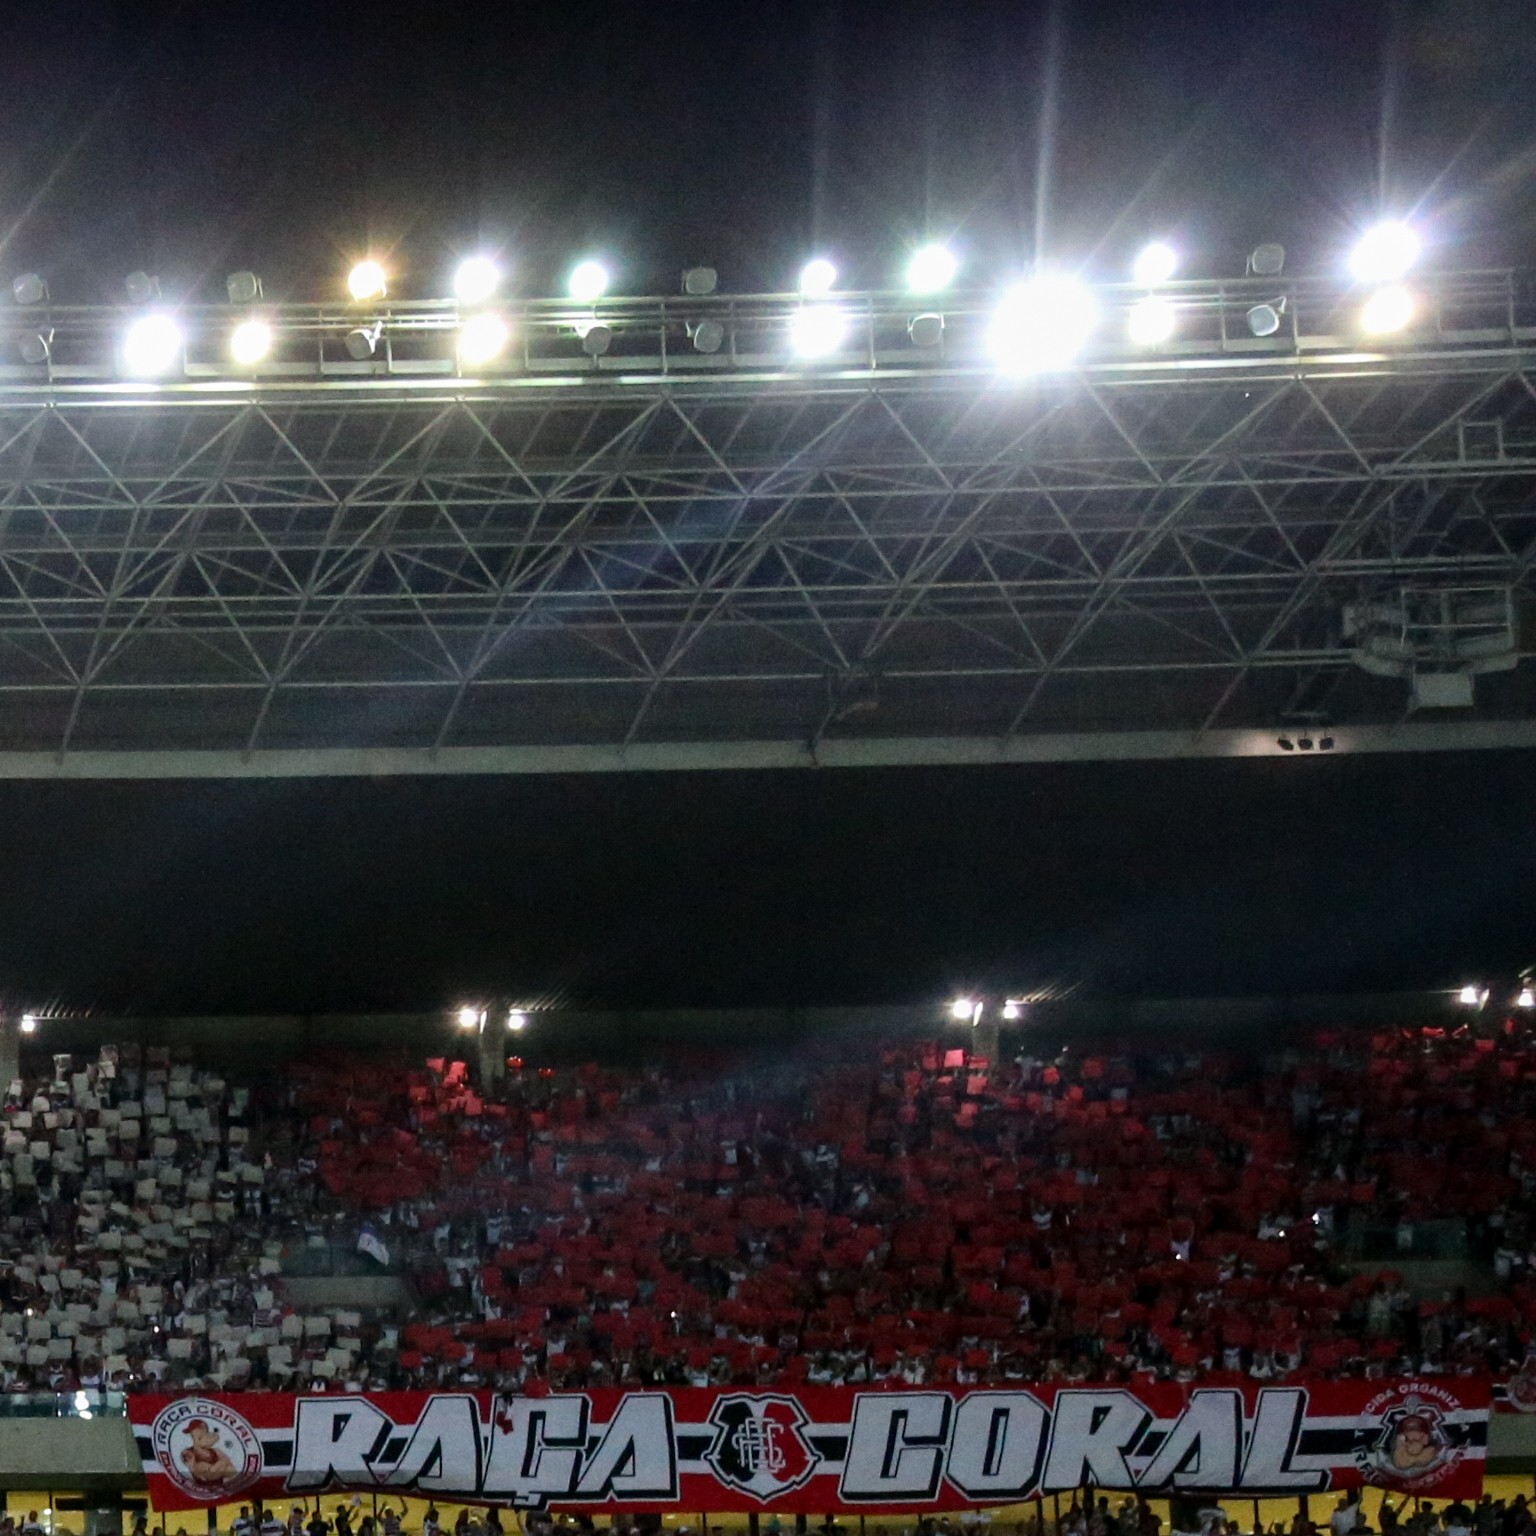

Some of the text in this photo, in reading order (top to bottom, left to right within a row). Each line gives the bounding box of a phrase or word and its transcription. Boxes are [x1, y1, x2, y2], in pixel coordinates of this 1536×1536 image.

[196, 1404, 253, 1448] CORAL
[286, 1393, 679, 1511] RAÇA
[839, 1389, 1330, 1501] CORAL
